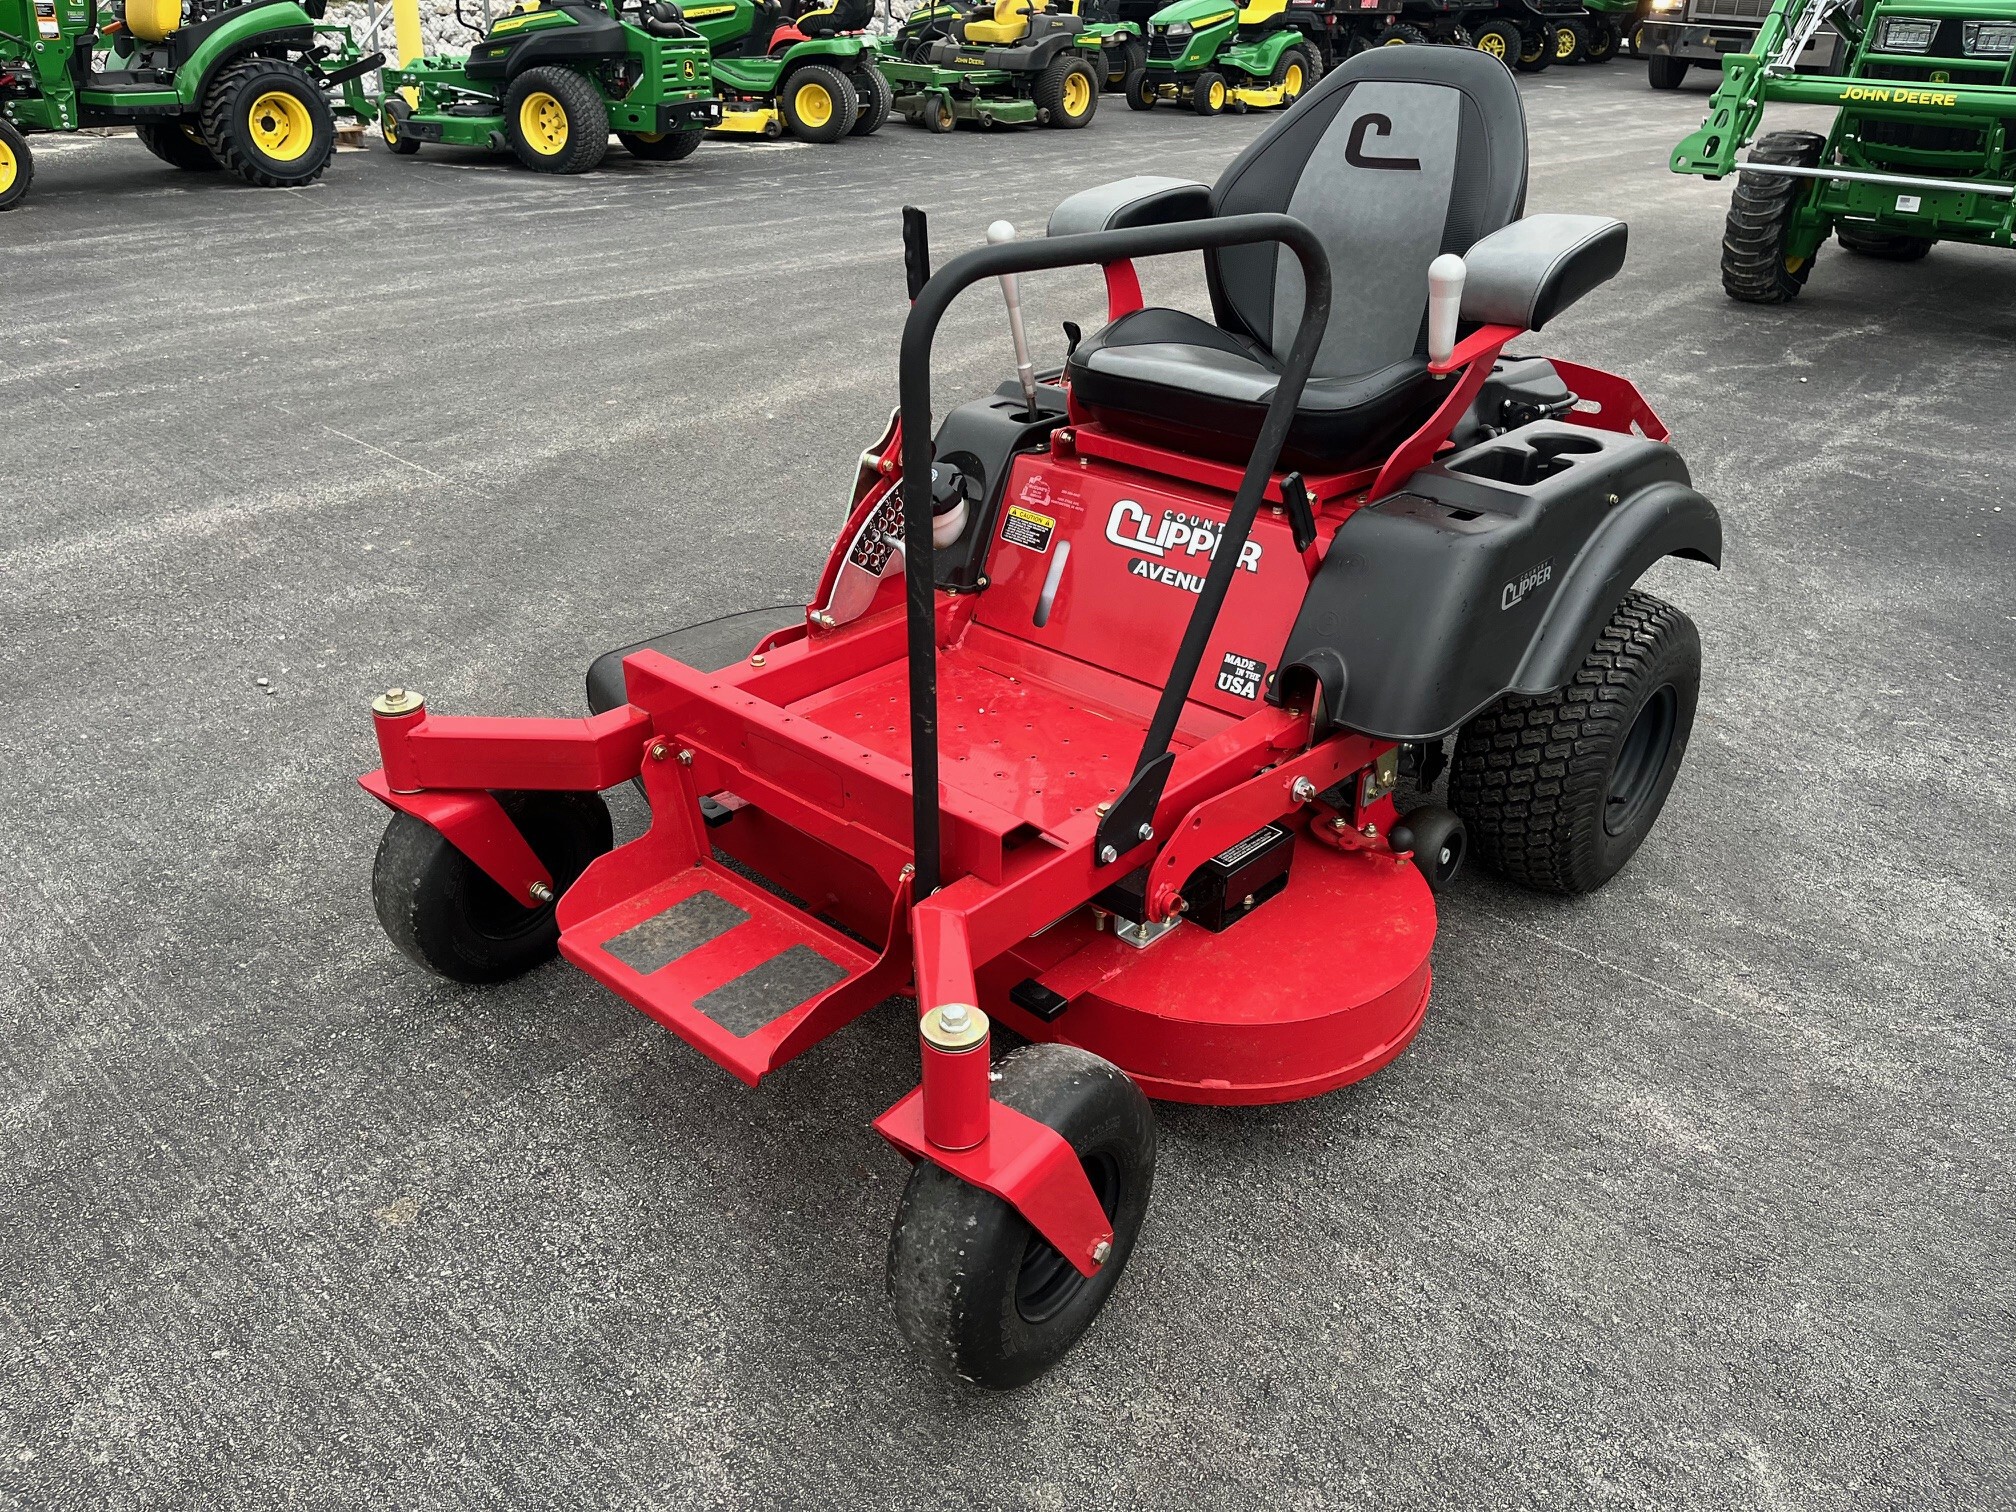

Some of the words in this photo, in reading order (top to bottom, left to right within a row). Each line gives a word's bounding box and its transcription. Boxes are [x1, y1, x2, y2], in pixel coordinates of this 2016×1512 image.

[954, 56, 968, 64] JOHN
[968, 57, 985, 66] DEERE
[1839, 85, 1891, 102] JOHN
[1893, 87, 1957, 107] DEERE
[1019, 511, 1043, 523] CAUTION
[1163, 509, 1252, 535] COUNT
[1105, 499, 1264, 573] CLIPPR
[1132, 560, 1206, 594] AVENU
[1501, 565, 1552, 611] CLIPPER
[1224, 653, 1256, 671] MADE
[1217, 672, 1255, 699] USA
[1235, 667, 1246, 677] IN
[1245, 670, 1261, 682] THE
